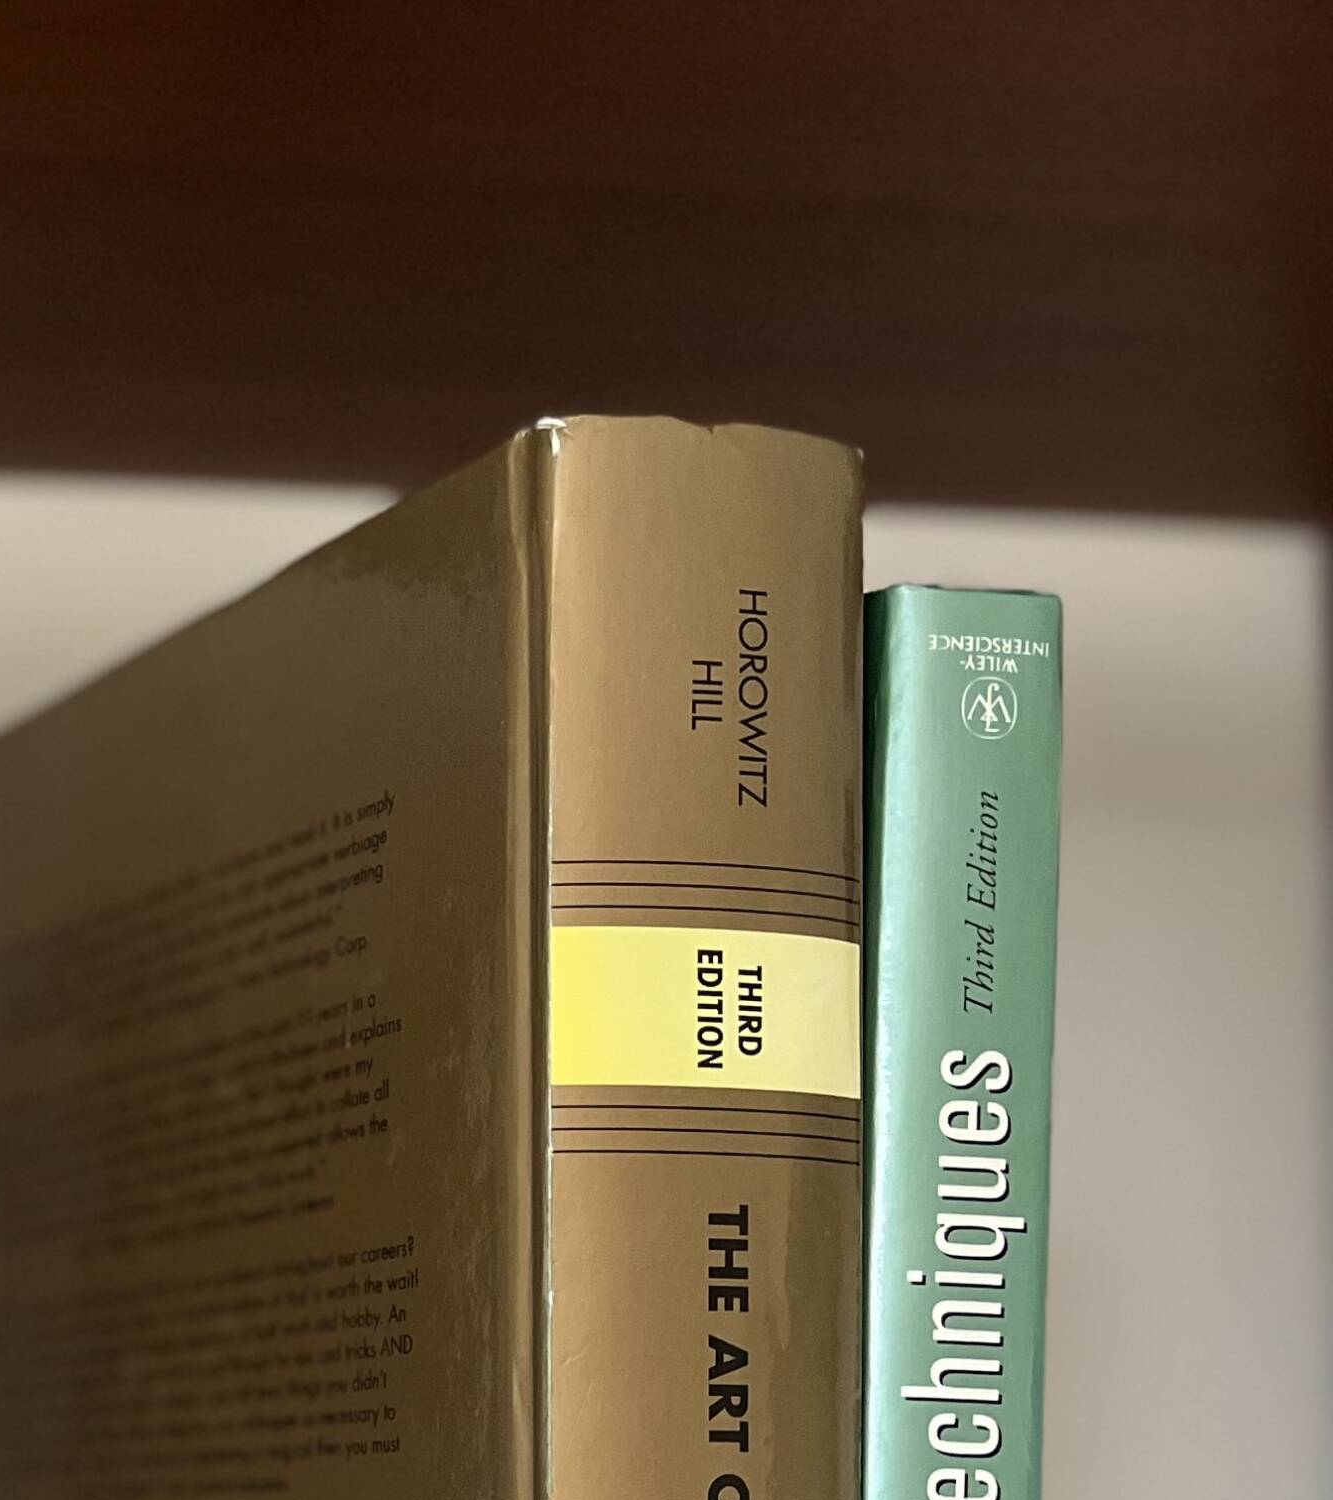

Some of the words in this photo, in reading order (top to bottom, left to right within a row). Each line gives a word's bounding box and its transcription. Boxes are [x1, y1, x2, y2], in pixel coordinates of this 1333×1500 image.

[928, 634, 1049, 658] INTERSCIENCE
[959, 654, 1018, 673] WILEY-
[691, 660, 723, 731] HILL
[738, 589, 768, 807] HOROWITZ
[356, 789, 395, 822] simply
[966, 790, 1000, 911] Edition
[964, 922, 996, 1014] Third
[696, 949, 723, 1069] EDITION
[738, 965, 763, 1057] THIRD
[349, 1016, 402, 1047] explains
[355, 1057, 374, 1078] my
[373, 1078, 390, 1102] all
[369, 1112, 389, 1135] the
[361, 1235, 415, 1265] careers?
[708, 1204, 749, 1313] THE
[363, 1272, 383, 1295] the
[386, 1267, 419, 1292] wait!
[388, 1303, 407, 1324] An
[380, 1333, 414, 1356] AND
[352, 1369, 387, 1392] didn't
[708, 1334, 749, 1453] ART
[383, 1403, 397, 1422] to
[371, 1435, 401, 1454] must
